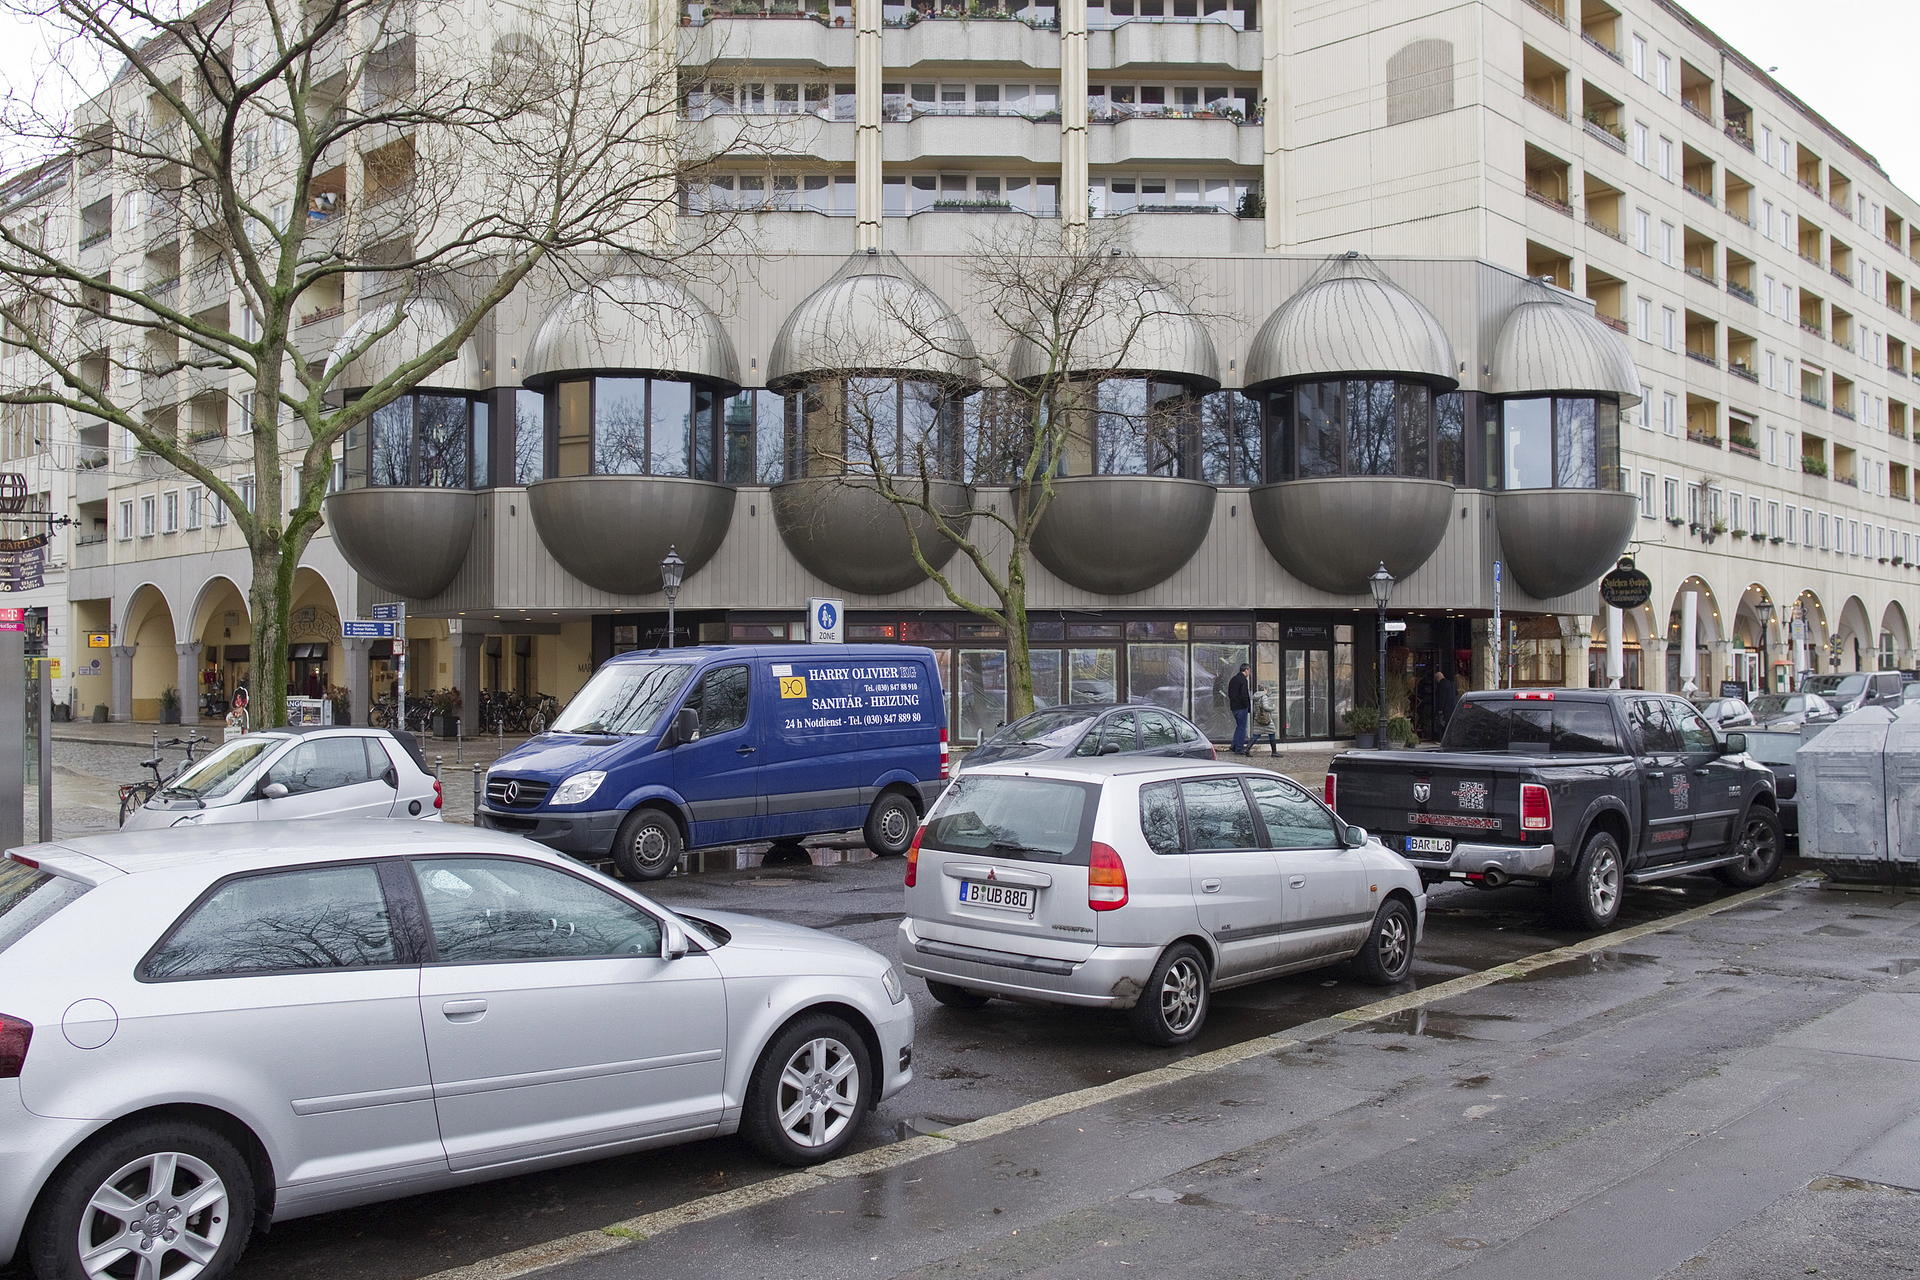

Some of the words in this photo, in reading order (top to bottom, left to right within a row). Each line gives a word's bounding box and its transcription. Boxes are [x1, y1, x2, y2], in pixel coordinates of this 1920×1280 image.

[819, 631, 836, 640] ZONE
[808, 668, 849, 681] HARRY
[851, 667, 899, 680] OLIVIER
[900, 666, 917, 679] KG
[864, 684, 875, 692] Tel.
[875, 683, 889, 692] (030)
[889, 683, 900, 691] 847
[900, 683, 907, 691] 88
[812, 694, 863, 710] SANITÄR
[870, 694, 920, 707] HEIZUNG
[785, 719, 795, 729] 24
[797, 719, 803, 728] h
[804, 717, 842, 728] Notdienst
[848, 716, 862, 726] Tel.
[864, 714, 883, 726] (030)
[883, 713, 896, 724] 847
[898, 712, 911, 723] 889
[912, 712, 921, 722] 80
[1411, 839, 1431, 851] BAR
[971, 885, 980, 900] B
[986, 887, 1003, 904] UB
[1004, 889, 1028, 907] 880
